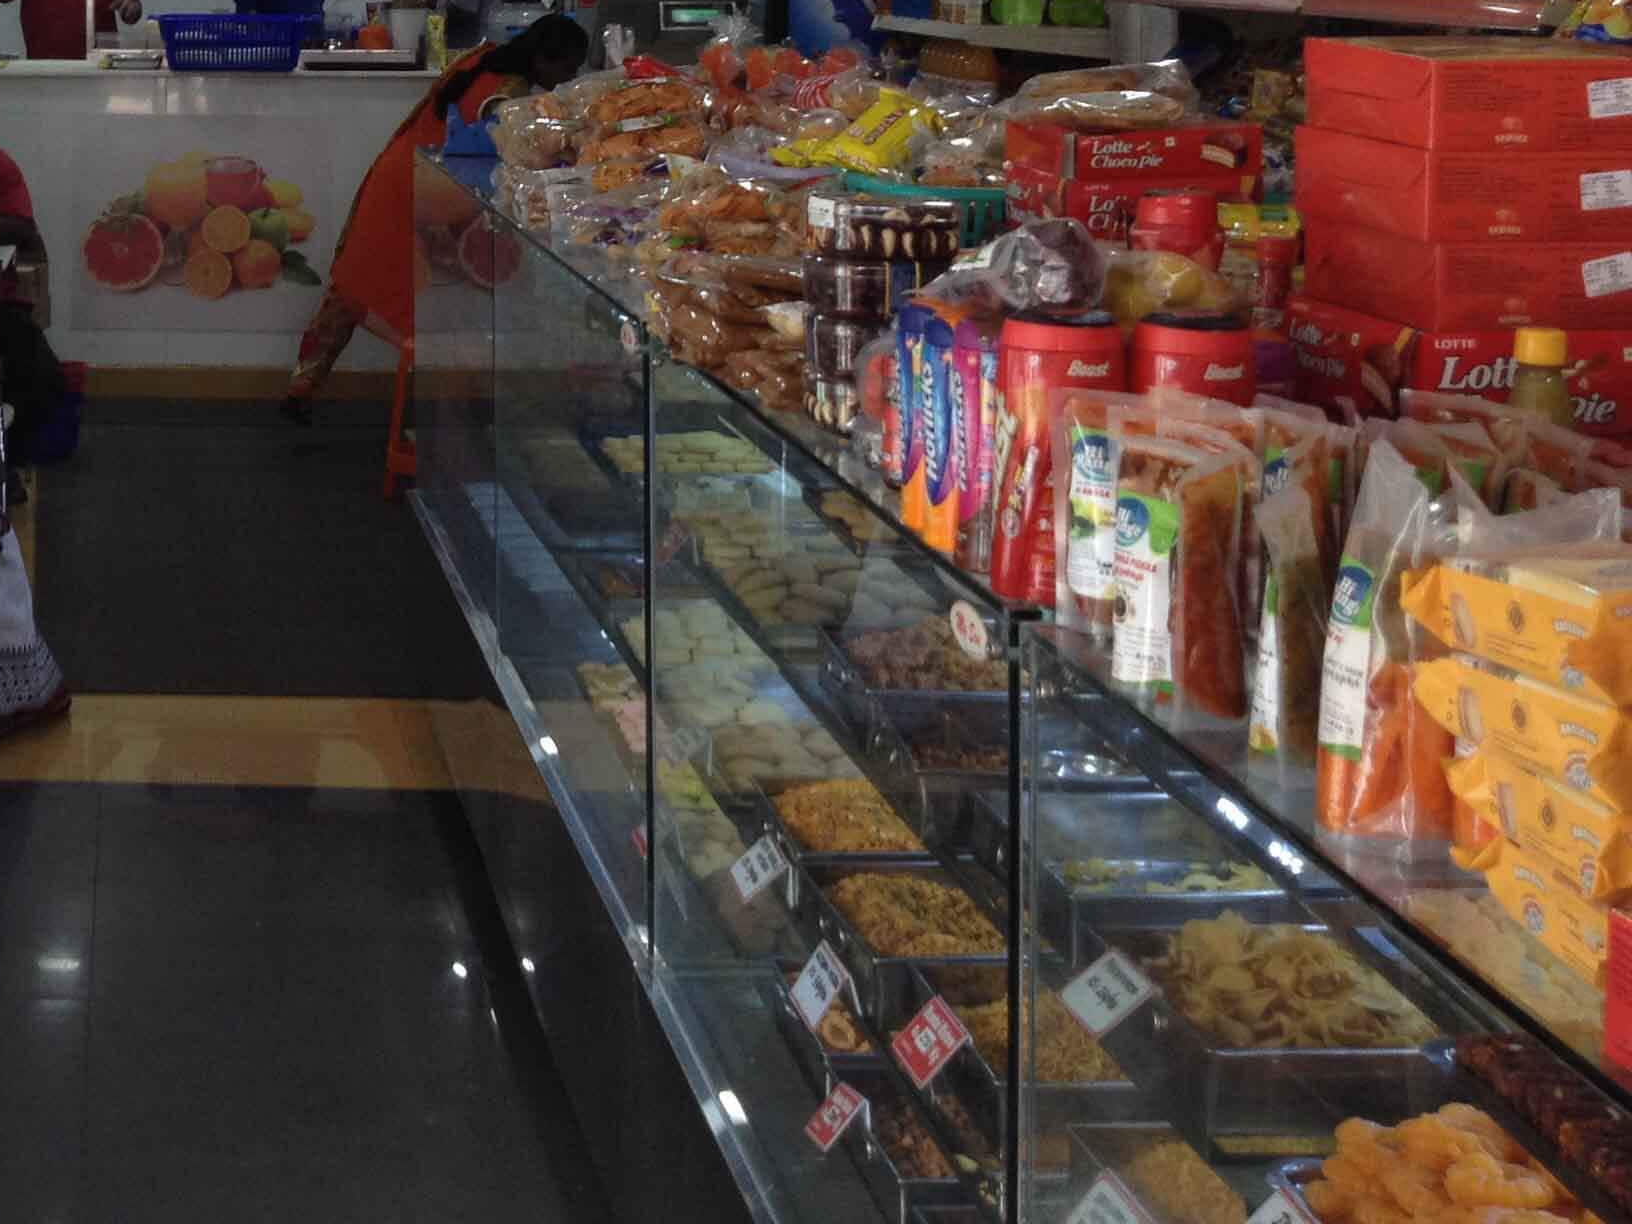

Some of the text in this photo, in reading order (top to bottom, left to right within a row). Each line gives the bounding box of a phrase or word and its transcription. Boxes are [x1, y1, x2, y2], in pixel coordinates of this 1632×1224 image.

[1091, 139, 1134, 155] Lotte
[1090, 155, 1138, 168] Choco
[1434, 338, 1478, 351] LOTTE
[1067, 359, 1110, 377] Boost
[1438, 356, 1519, 391] Lott
[921, 361, 938, 482] Horlicks
